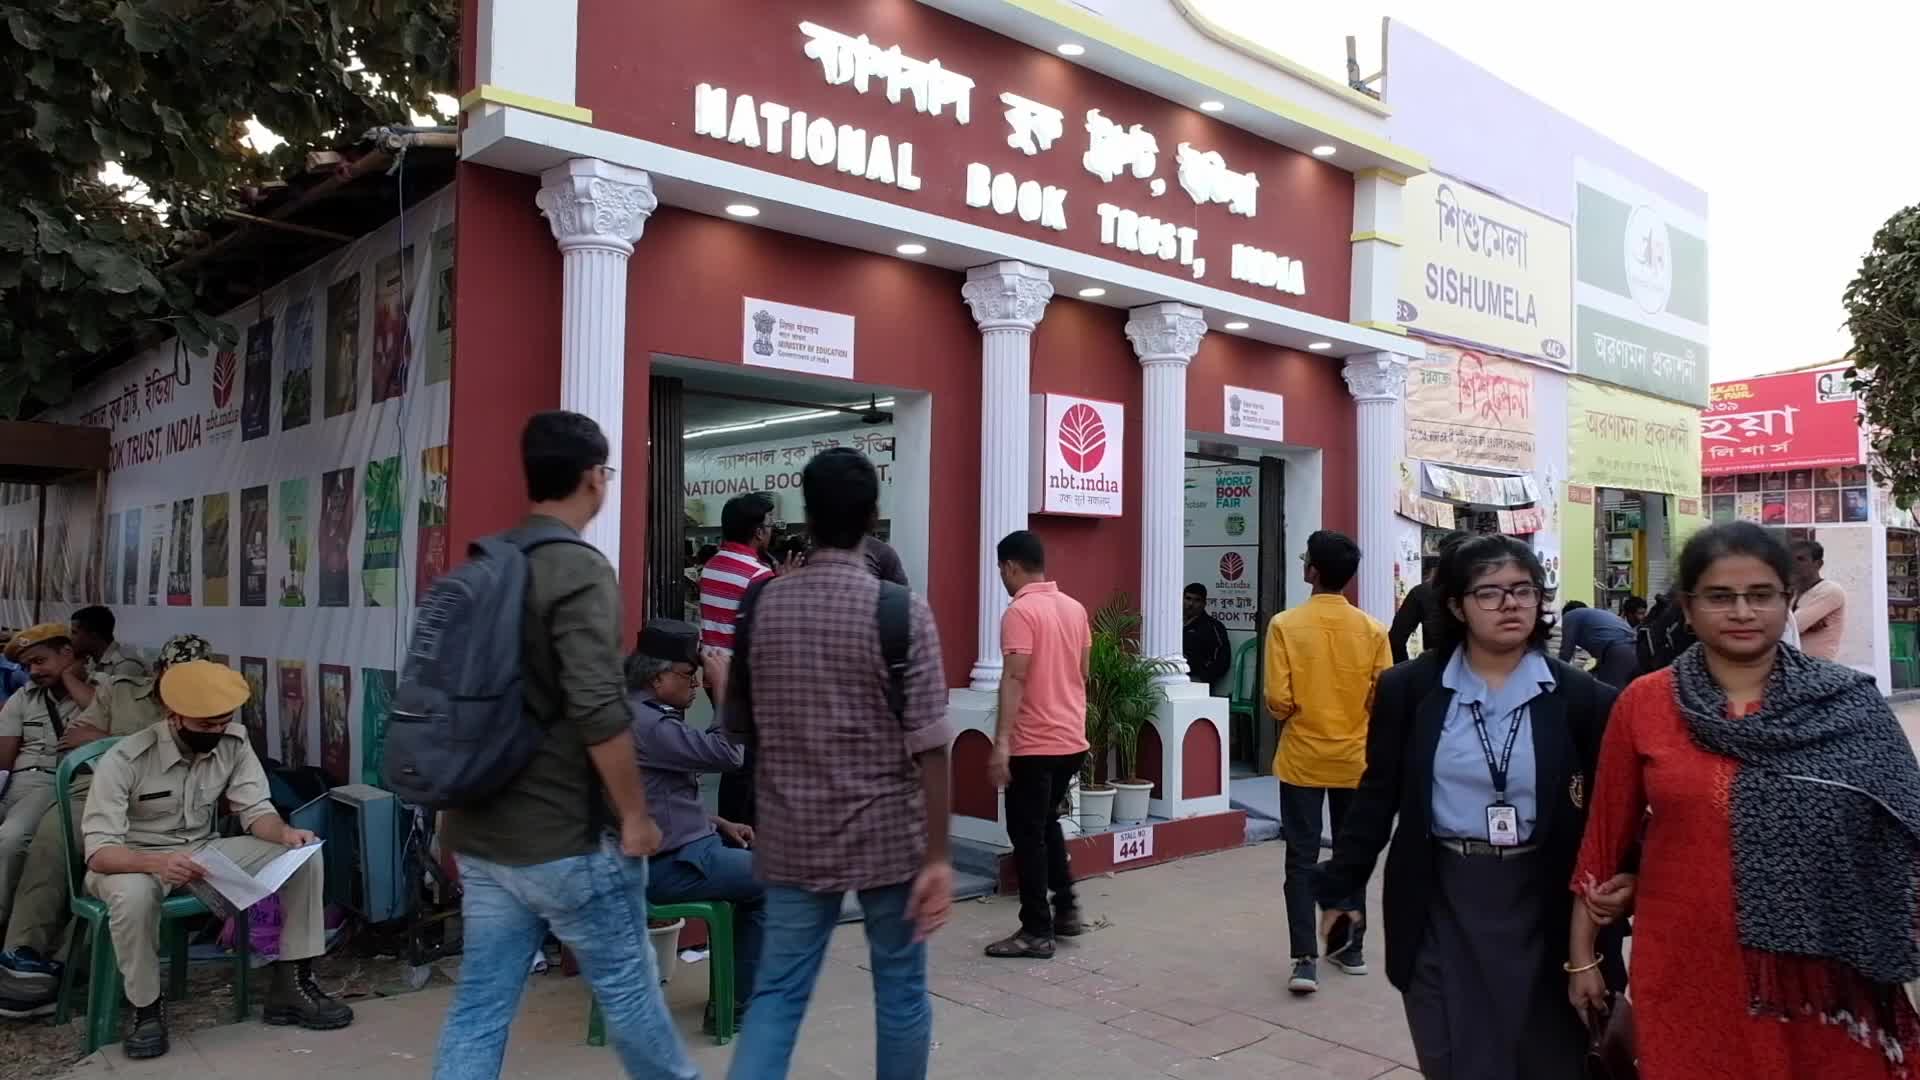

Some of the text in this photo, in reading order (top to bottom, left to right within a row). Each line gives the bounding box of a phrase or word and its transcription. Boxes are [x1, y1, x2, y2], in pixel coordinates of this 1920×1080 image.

[694, 82, 1305, 295] NATIONAL BOOK TRUST, INDIA
[1426, 262, 1538, 328] SISHUMELA
[816, 346, 848, 358] EDUCATION
[1701, 404, 1800, 443] হুয়া
[127, 426, 163, 467] TRUST,
[167, 413, 201, 457] INDIA
[781, 446, 807, 466] বুক
[683, 472, 803, 497] NATIONAL BOO
[1050, 469, 1118, 493] nbt.india
[1216, 476, 1252, 486] WORLD
[1216, 486, 1250, 498] BOOK
[1216, 498, 1240, 508] FAIR
[1211, 611, 1239, 622] BOOK
[1121, 831, 1136, 840] STALL
[1120, 839, 1145, 858] 441
